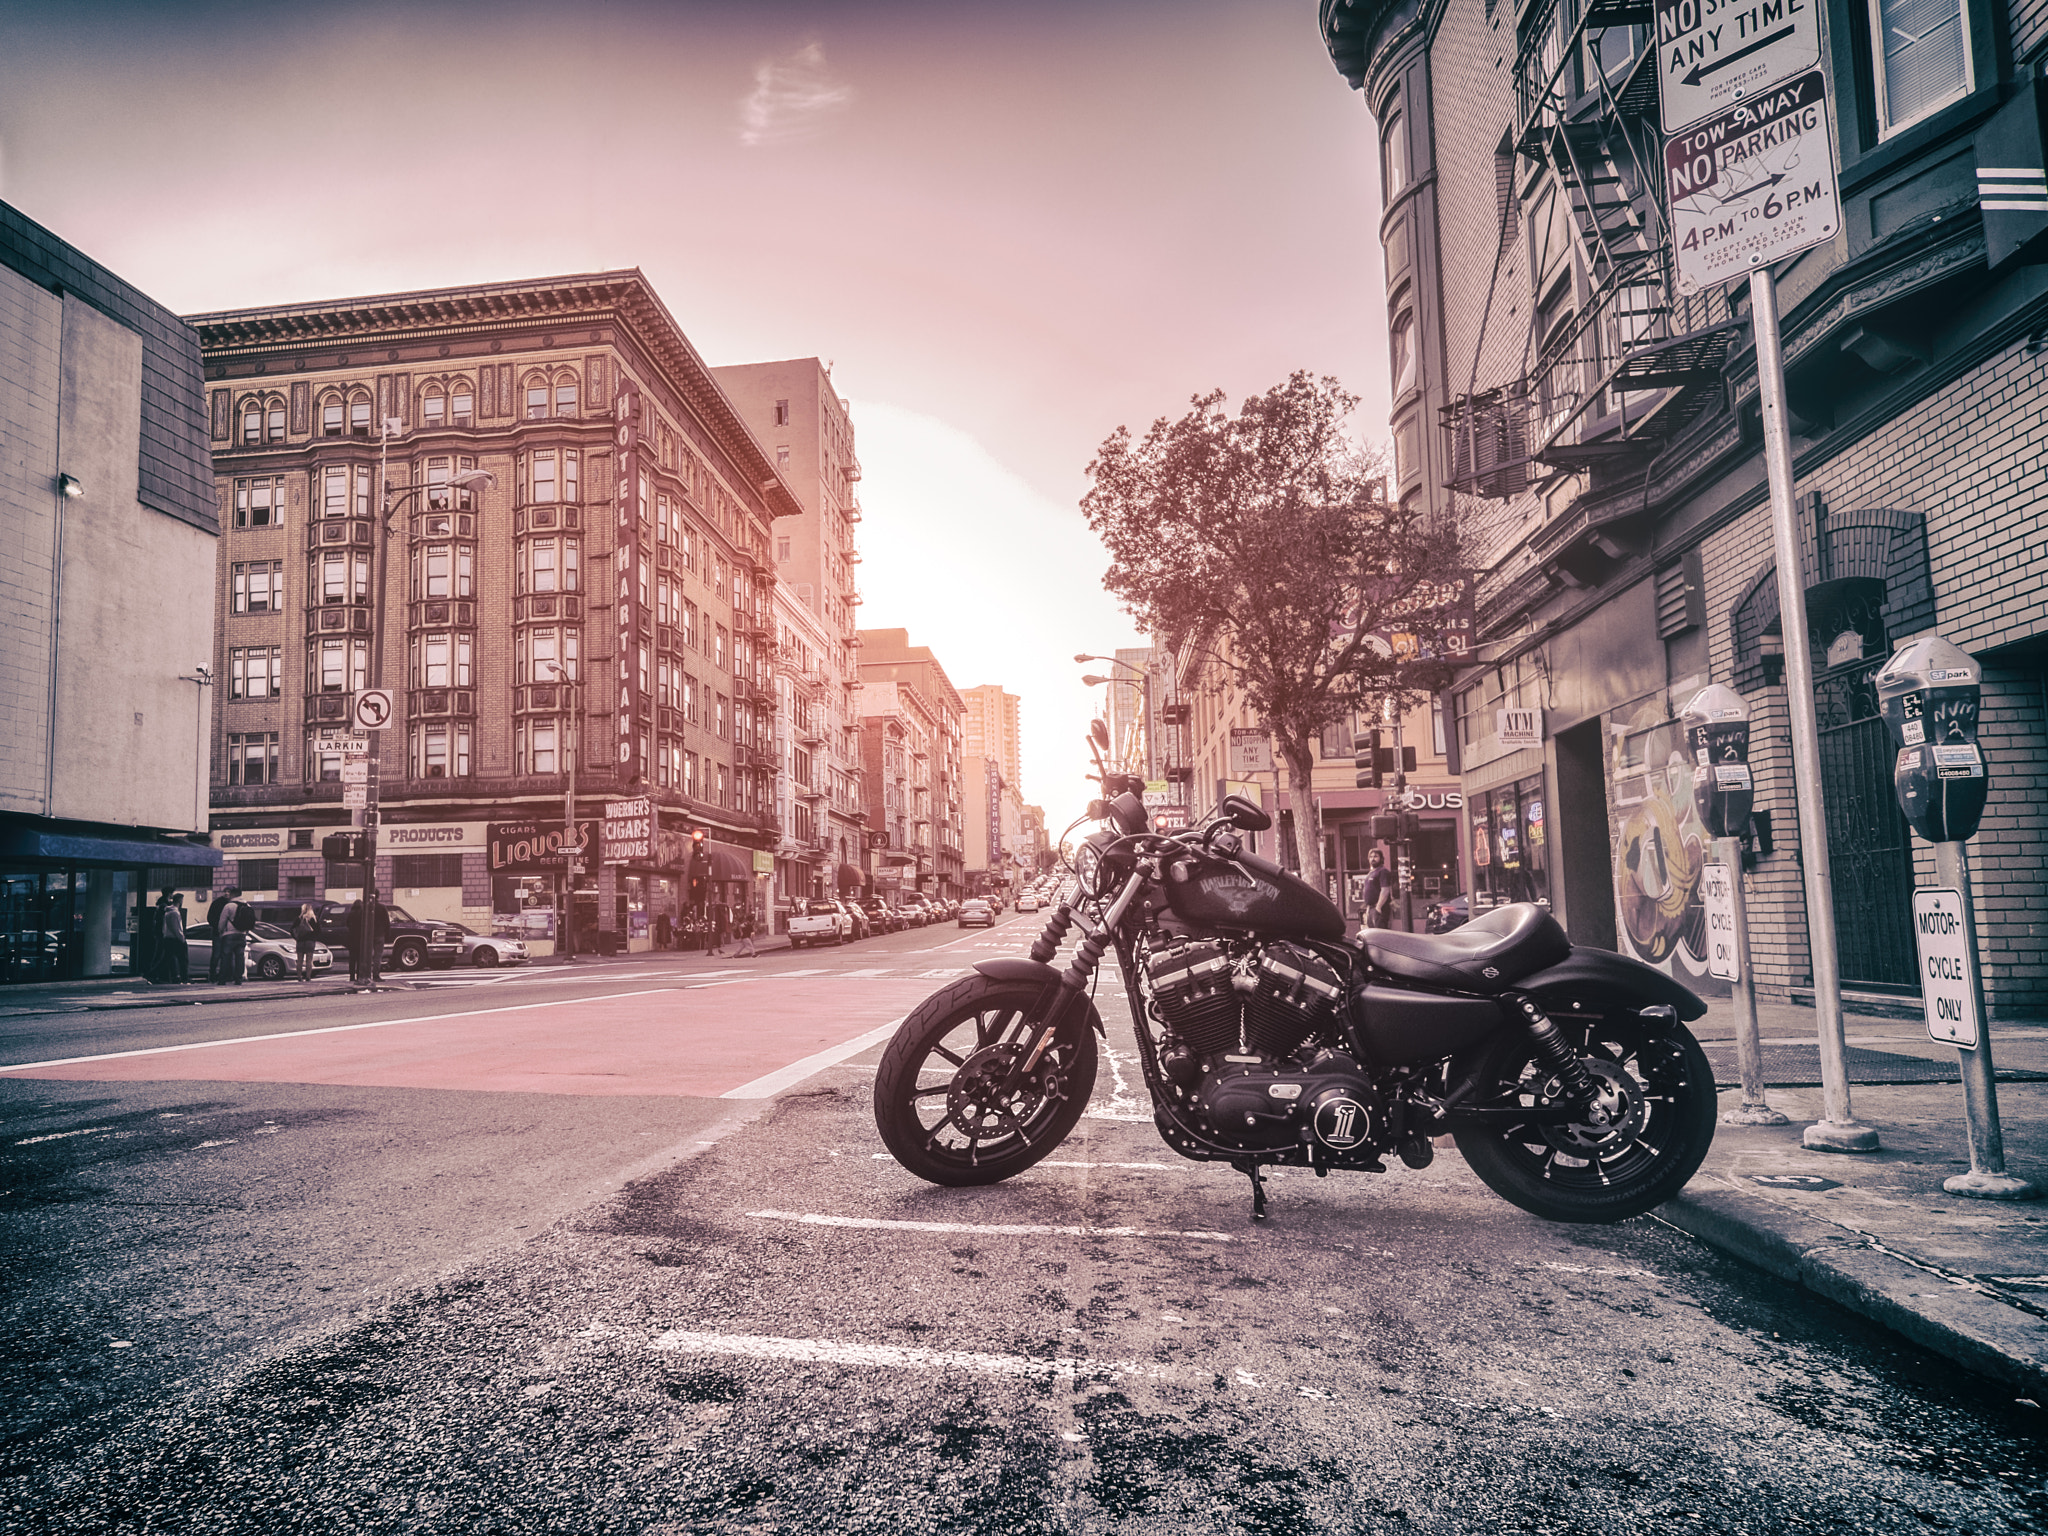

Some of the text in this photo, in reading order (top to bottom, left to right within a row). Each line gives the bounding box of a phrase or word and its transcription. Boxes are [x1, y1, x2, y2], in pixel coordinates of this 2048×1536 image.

[1659, 0, 1696, 43] NO
[1670, 23, 1723, 74] ANY
[1735, 0, 1804, 39] TIME
[1710, 83, 1723, 93] FOR
[1725, 72, 1746, 86] TOWED
[1748, 62, 1767, 75] CARS
[1710, 86, 1731, 100] PHONE
[1733, 69, 1768, 90] 553-1235
[1681, 82, 1805, 156] TOW-AWAY
[1671, 106, 1817, 196] NO PARKING
[1741, 206, 1760, 223] TO
[1703, 241, 1741, 261] EXCEPT
[1745, 231, 1767, 244] SAT.
[1784, 215, 1808, 228] SUN.
[1707, 253, 1741, 271] PHONE
[1754, 227, 1806, 252] 553-1235
[1710, 223, 1801, 263] FOR TOWED CARS
[616, 391, 629, 528] HOTEL
[616, 543, 630, 765] HARTLAND
[1504, 712, 1534, 731] ATM
[318, 742, 363, 751] LARKIN
[1231, 736, 1242, 746] NO
[1242, 755, 1260, 763] TIME
[605, 798, 650, 818] WOERNER'S
[220, 833, 280, 848] GROCERIES
[389, 827, 464, 843] PRODUCTS
[500, 826, 536, 835] CIGARS
[605, 819, 650, 840] CIGARS
[492, 822, 590, 869] LIQUORS
[604, 841, 649, 858] LIQUORS
[1711, 913, 1732, 931] CYCLE
[1919, 912, 1960, 935] MOTOR-
[1928, 956, 1963, 981] CYCLE
[1936, 997, 1962, 1022] ONLY
